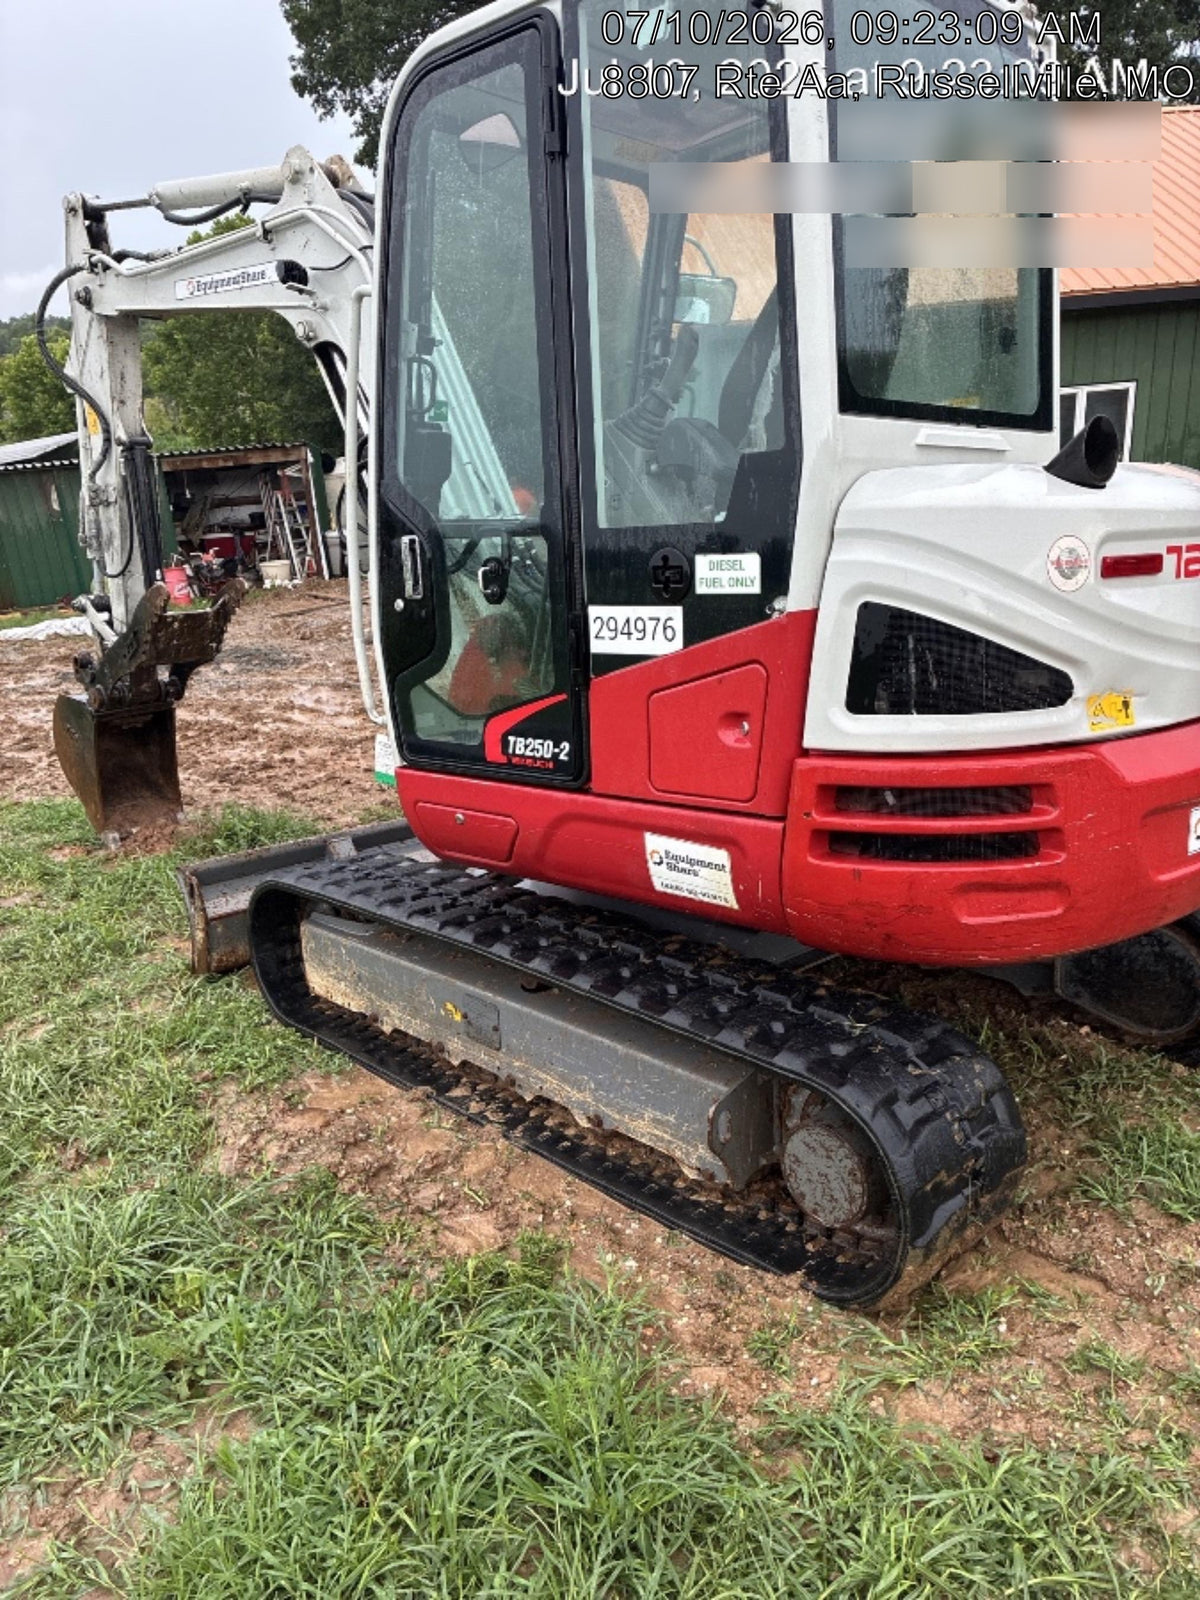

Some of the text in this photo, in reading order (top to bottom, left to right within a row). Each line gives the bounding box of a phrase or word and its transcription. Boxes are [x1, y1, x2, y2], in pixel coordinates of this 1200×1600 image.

[708, 559, 746, 572] DIESEL
[699, 576, 757, 589] FUEL ONLY
[593, 616, 676, 642] 294976
[507, 735, 571, 761] TB250-2
[664, 849, 728, 873] Equipment
[665, 861, 700, 877] Share
